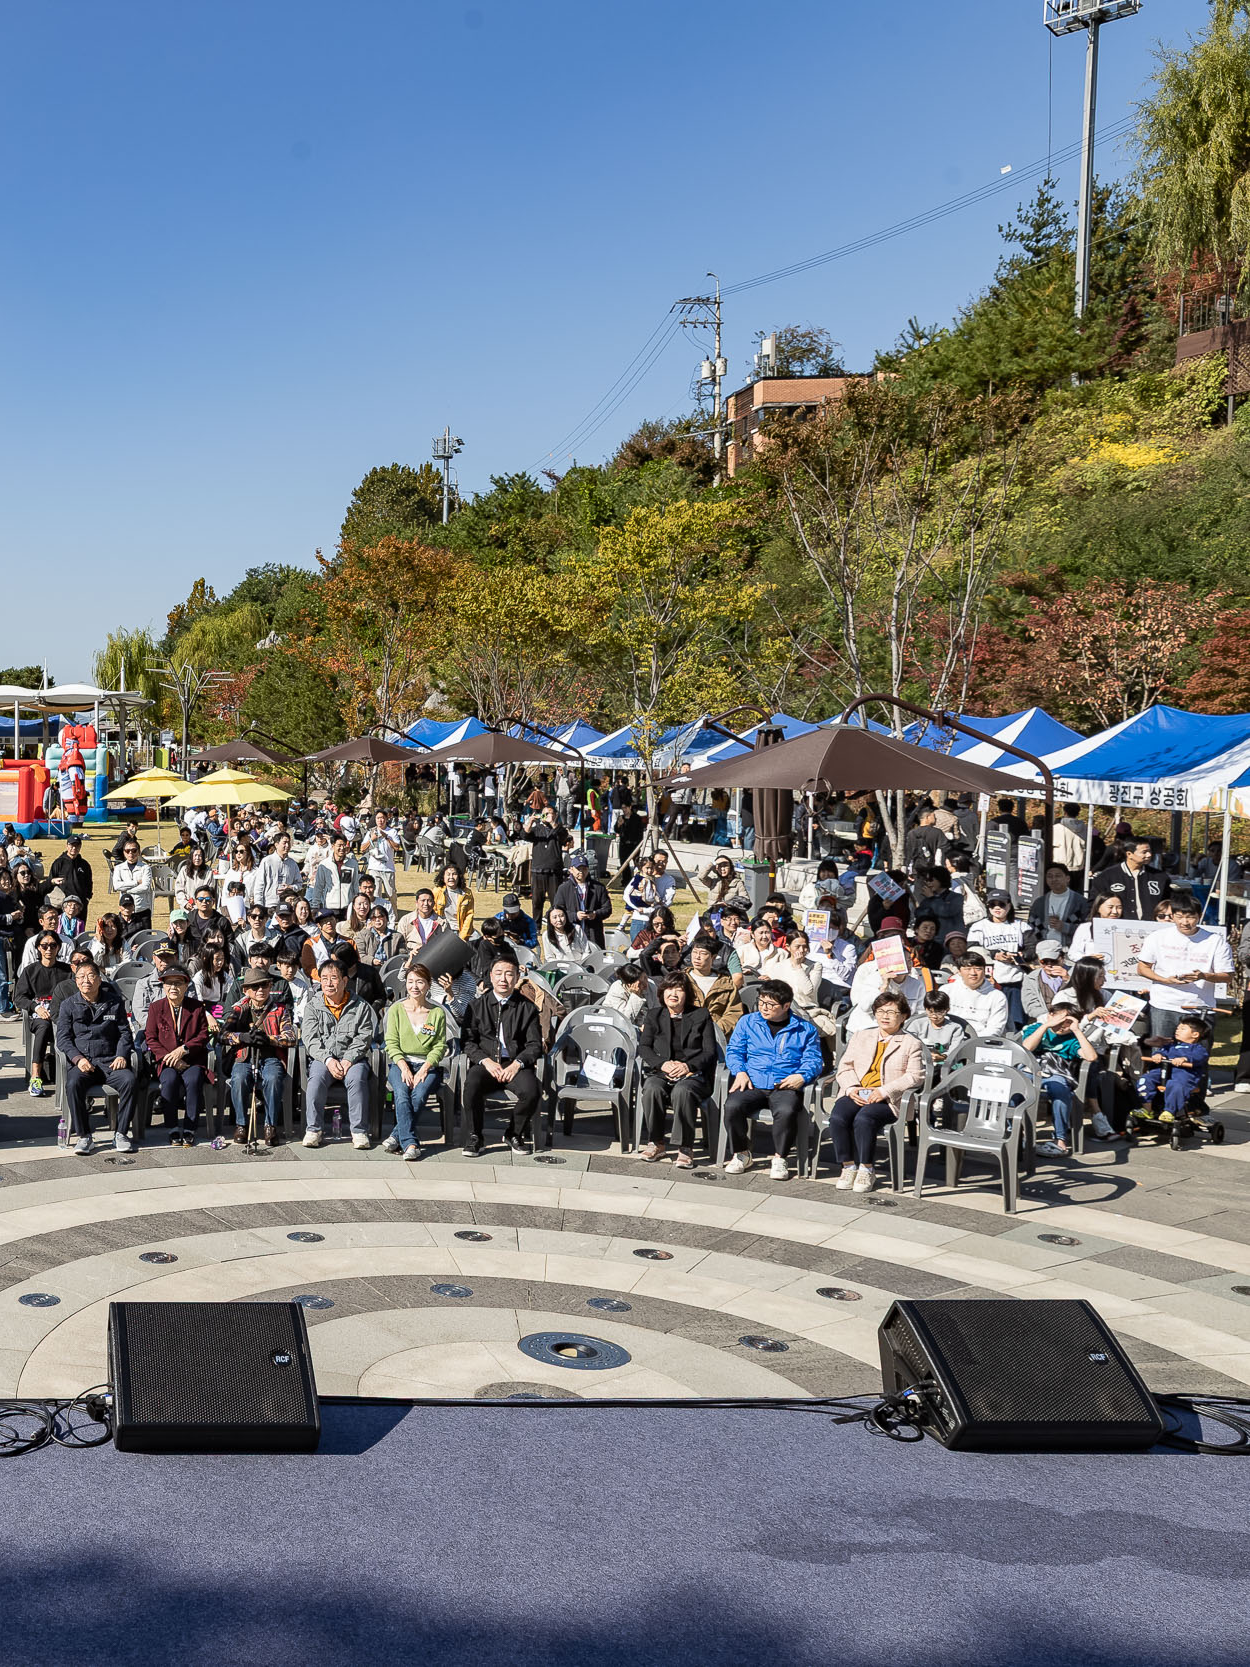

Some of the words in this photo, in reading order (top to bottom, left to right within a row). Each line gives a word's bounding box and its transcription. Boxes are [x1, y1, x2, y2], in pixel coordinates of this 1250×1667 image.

[1109, 784, 1144, 805] 광진구
[1150, 786, 1189, 808] 상공회
[1147, 880, 1161, 896] S
[275, 1355, 290, 1363] RCF
